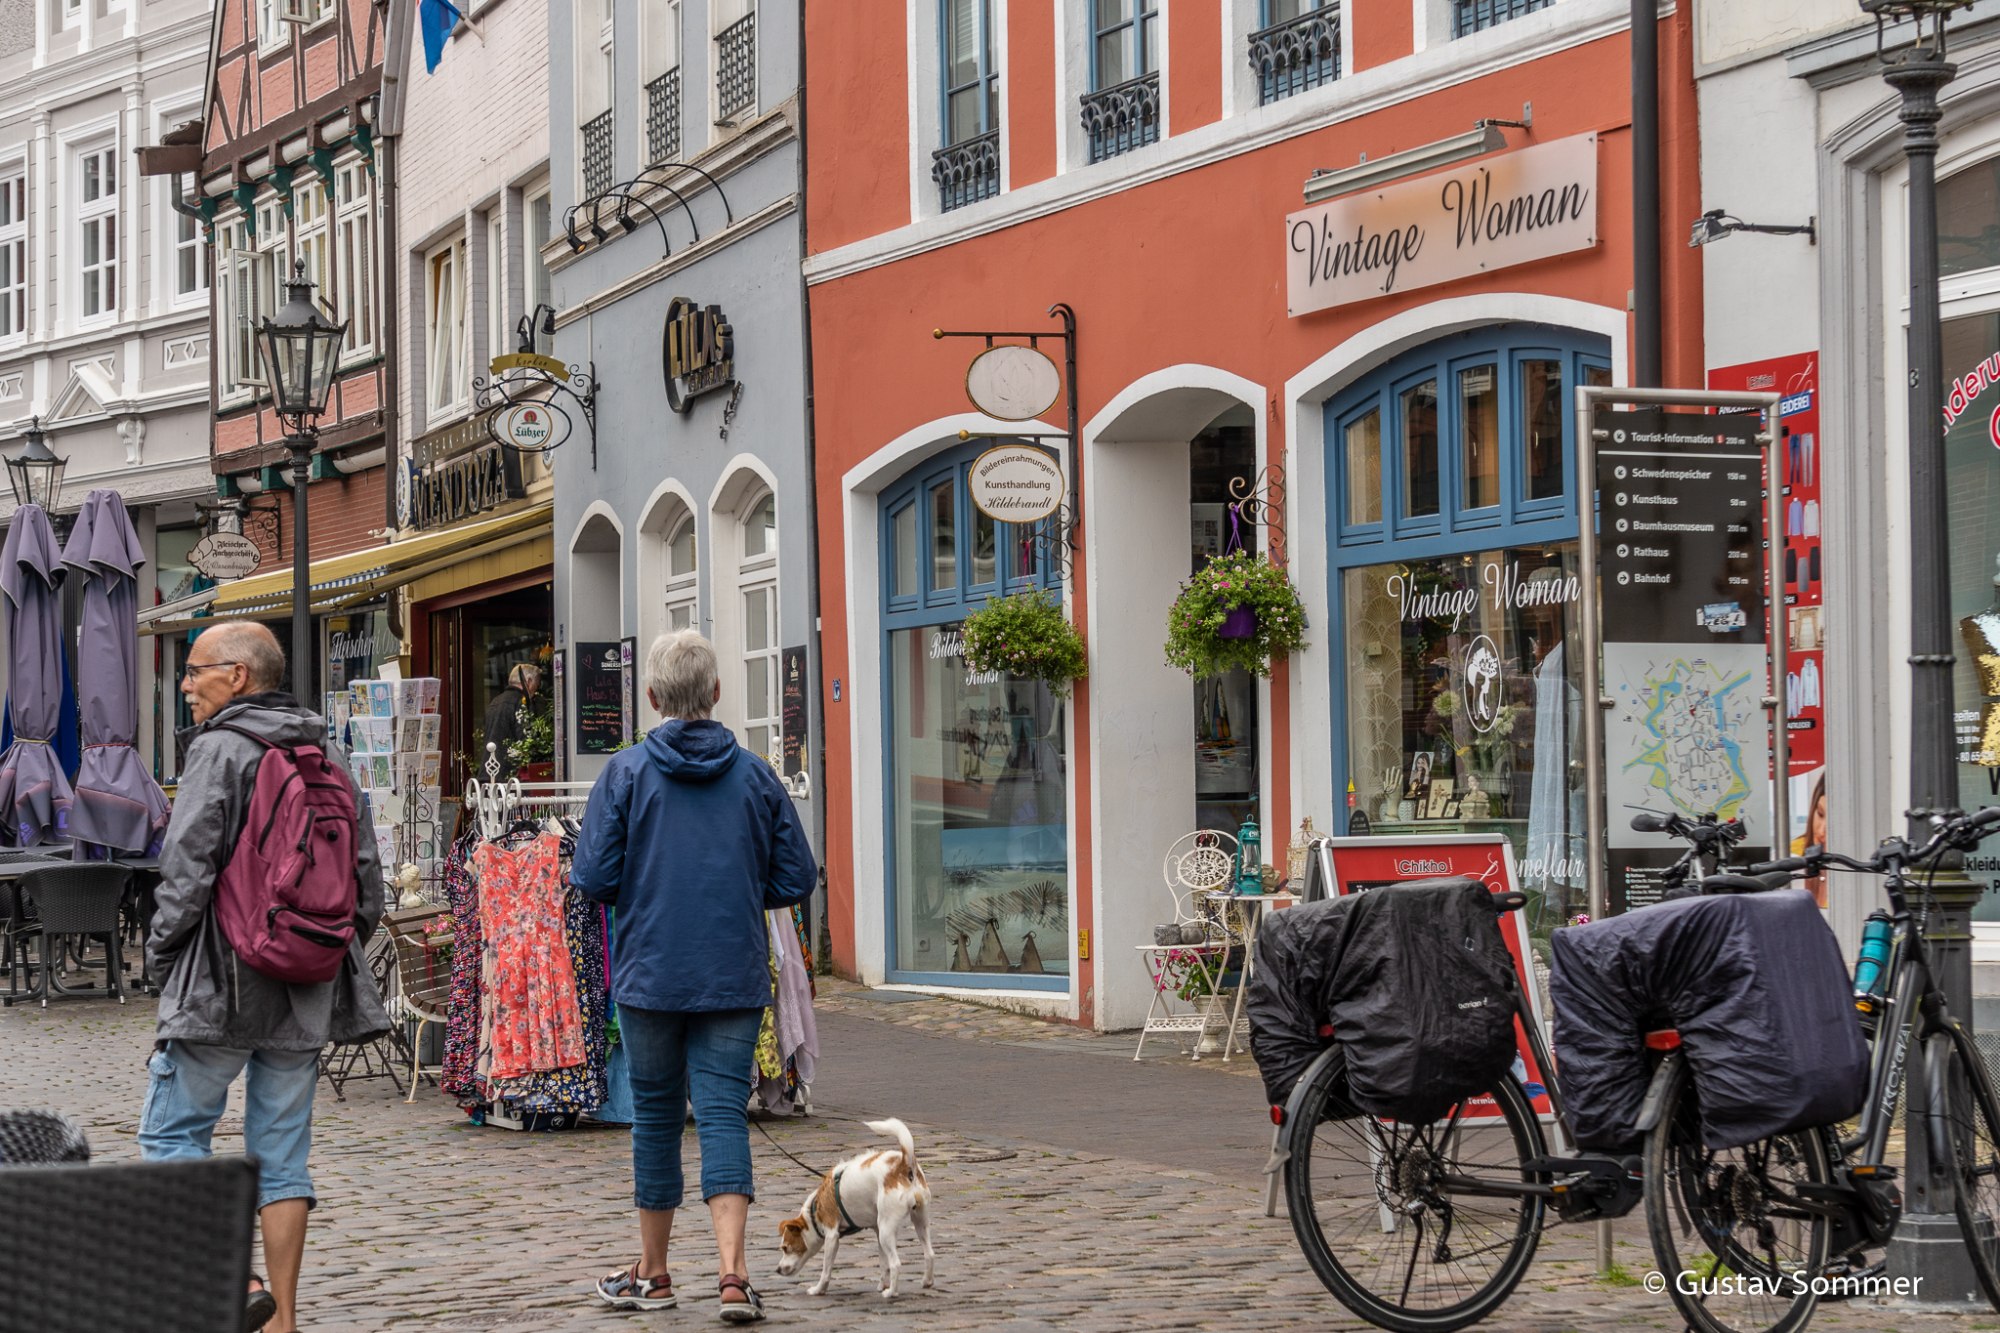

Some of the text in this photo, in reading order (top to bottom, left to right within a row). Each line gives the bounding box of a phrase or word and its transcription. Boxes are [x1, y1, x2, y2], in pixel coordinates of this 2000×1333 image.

[1291, 170, 1588, 293] Vintage Woman
[515, 427, 546, 438] Lübzer
[1631, 432, 1714, 444] Tourist-Information
[422, 434, 453, 460] STEAK
[980, 454, 1056, 477] Bildereinrahmungen
[1632, 468, 1712, 480] Schwedenspeicher
[413, 447, 508, 532] MENDOZA
[985, 480, 1051, 490] Kunsthandlung
[984, 497, 1052, 509] Hildebrandt
[1632, 495, 1678, 505] Kunsthaus
[1633, 521, 1714, 532] Baumhausmuseum
[217, 541, 248, 549] Fleischer
[1634, 547, 1669, 557] Rathaus
[1634, 574, 1671, 584] Bahnhof
[1387, 560, 1581, 632] Vintage Woman
[332, 629, 380, 661] Fleischerei
[1953, 710, 1980, 722] zeiten
[1400, 860, 1447, 873] Chikho
